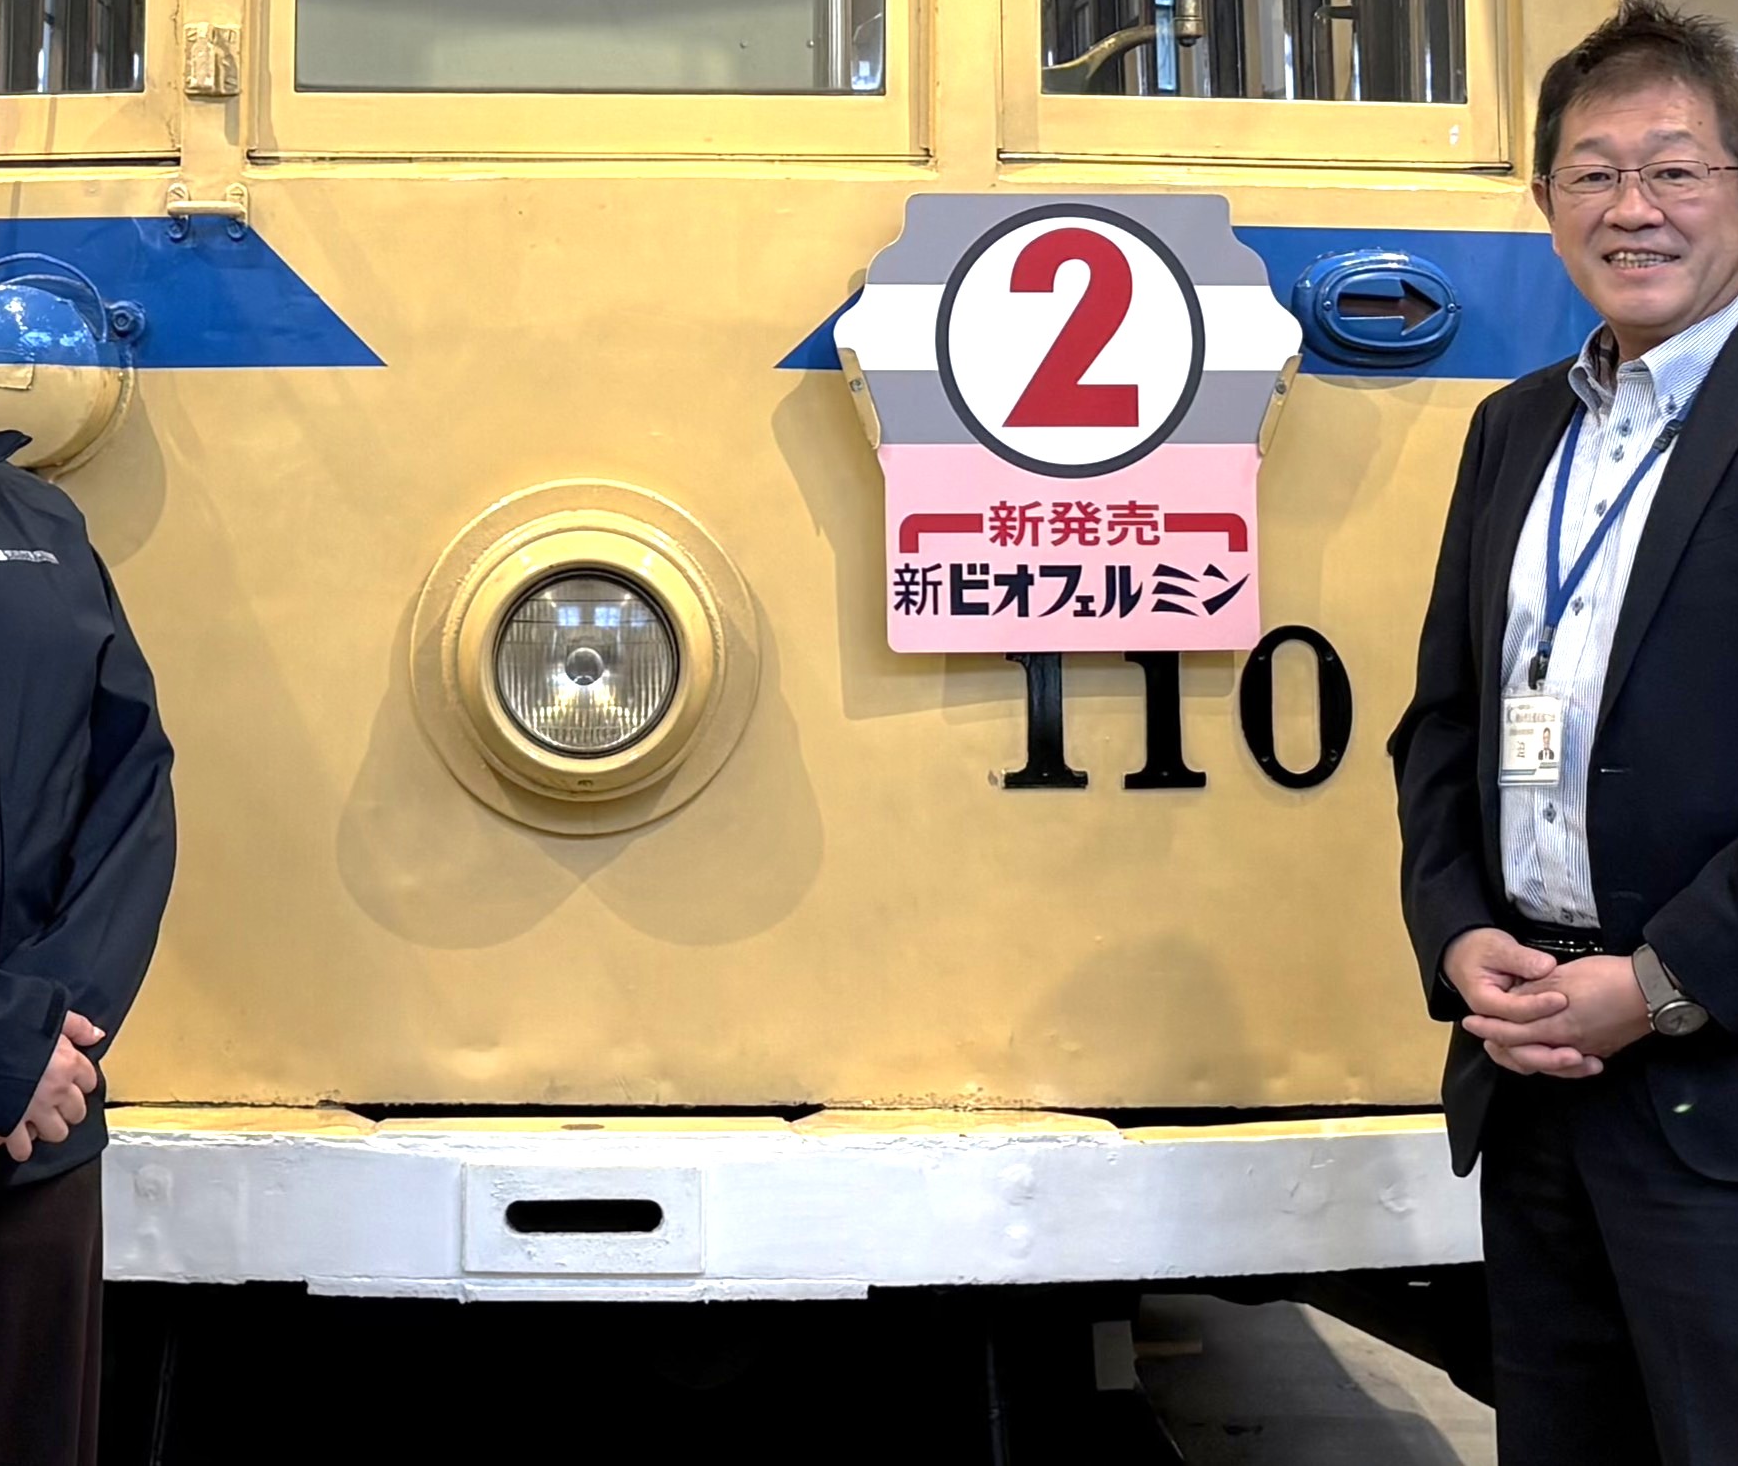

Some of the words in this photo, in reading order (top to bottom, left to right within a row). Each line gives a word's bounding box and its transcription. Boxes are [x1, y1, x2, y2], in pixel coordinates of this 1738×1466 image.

[1003, 227, 1140, 428] 2
[988, 500, 1162, 548] 新発売
[892, 562, 1251, 620] 新ビオフェルミン
